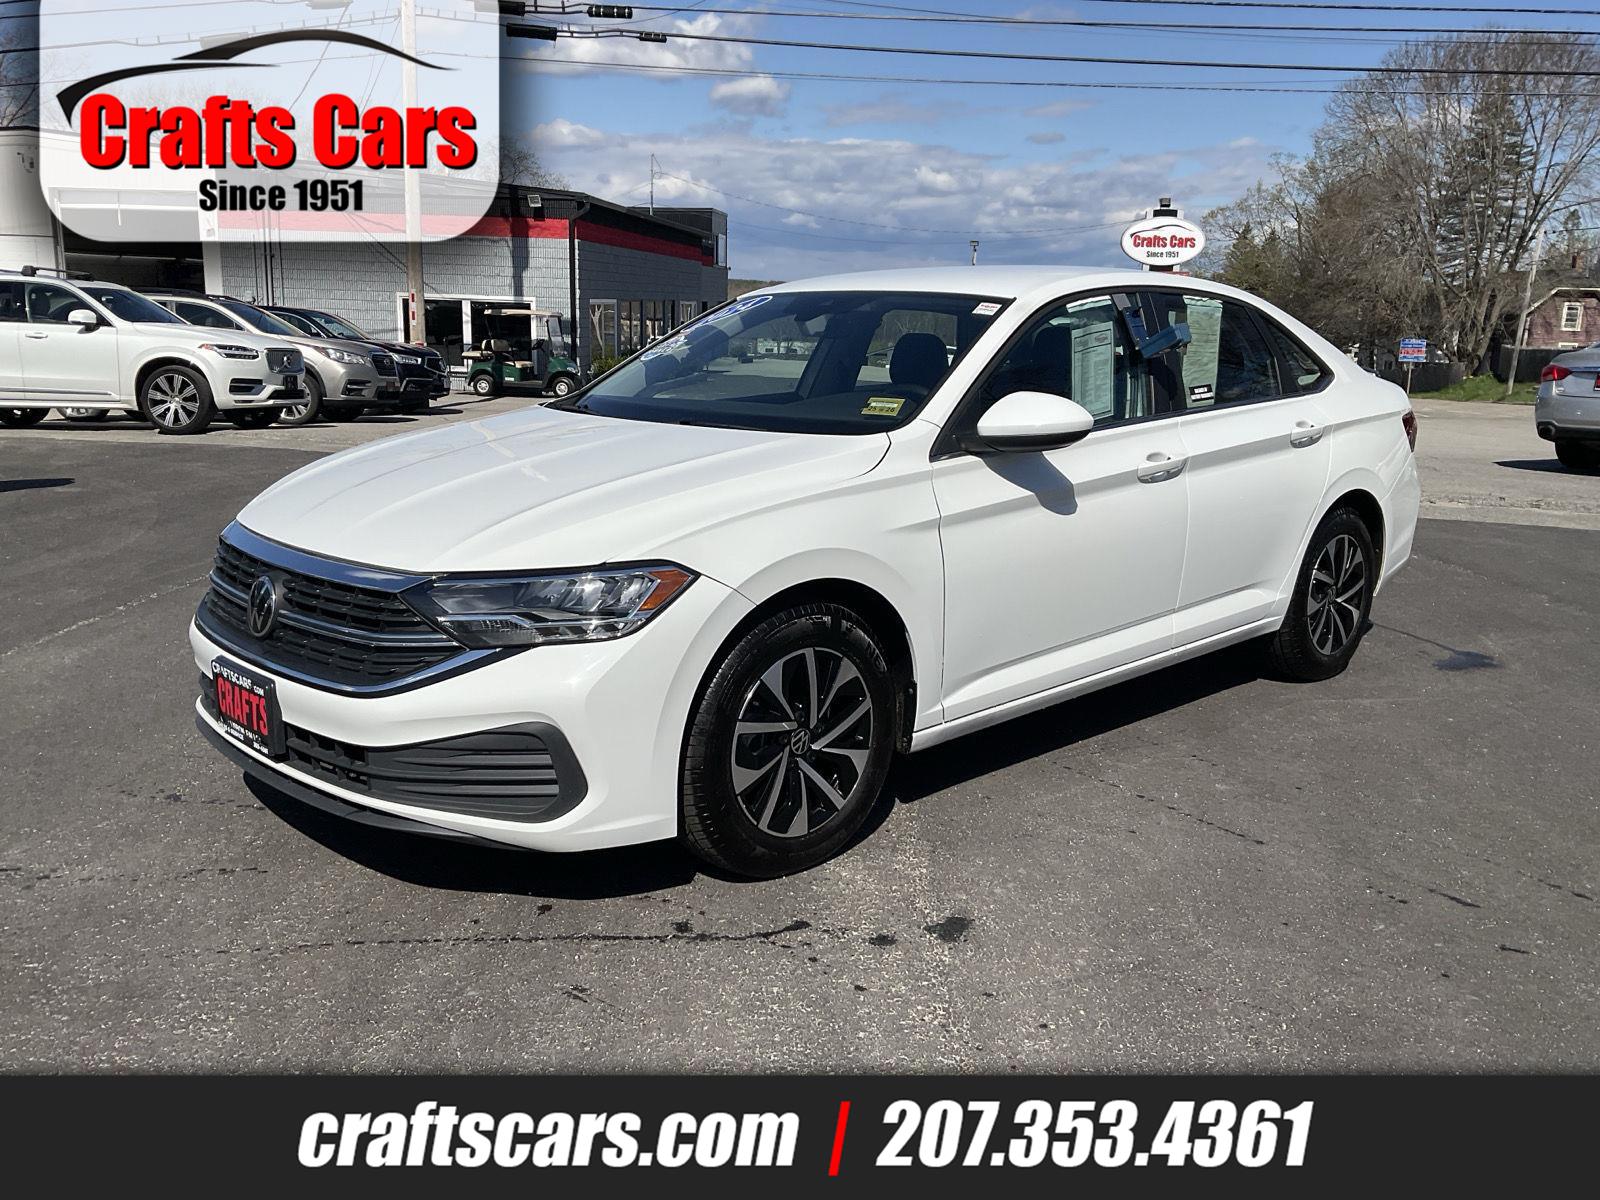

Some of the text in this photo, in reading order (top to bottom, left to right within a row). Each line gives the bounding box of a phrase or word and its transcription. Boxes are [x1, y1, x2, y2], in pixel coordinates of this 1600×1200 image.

[1132, 234, 1196, 248] Crafts Cars
[1146, 250, 1179, 258] Since 1951
[217, 676, 269, 736] CRAFTS
